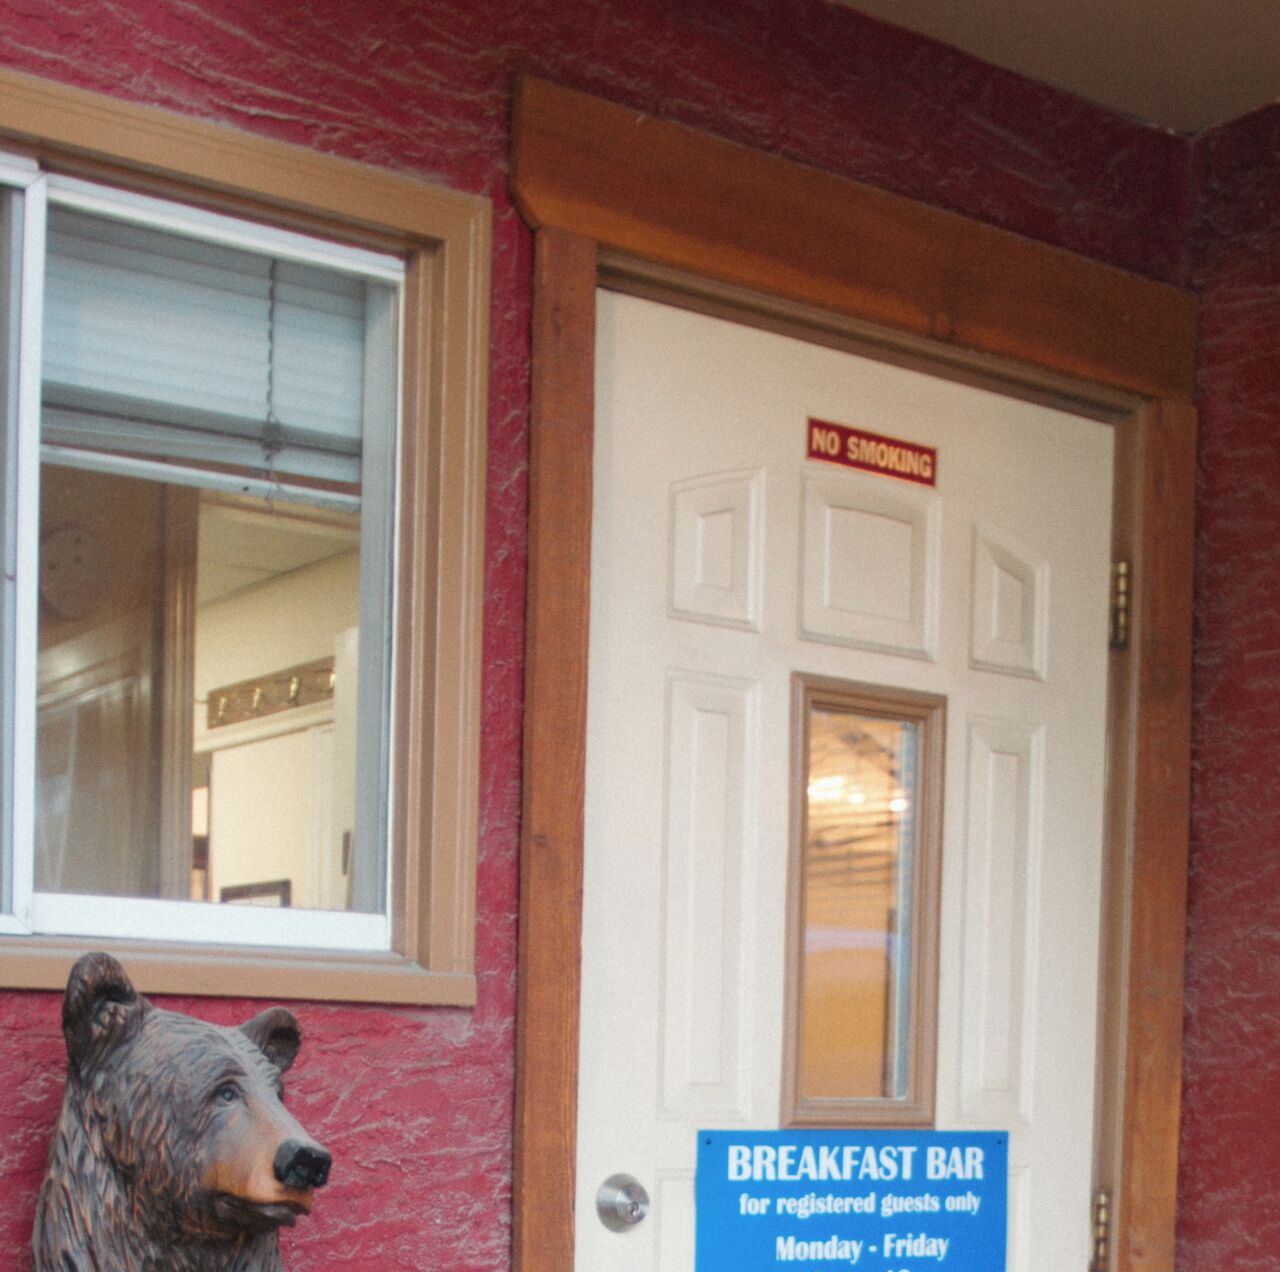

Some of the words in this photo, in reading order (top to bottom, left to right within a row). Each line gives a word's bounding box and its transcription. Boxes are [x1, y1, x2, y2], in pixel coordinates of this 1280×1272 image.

[811, 427, 841, 456] NO
[847, 435, 932, 479] SMOKING
[727, 1145, 917, 1181] BREAKFAST
[926, 1146, 984, 1180] BAR
[739, 1193, 771, 1215] for
[776, 1192, 876, 1219] registered
[880, 1193, 940, 1217] guests
[945, 1191, 981, 1214] only
[776, 1235, 863, 1264] Monday
[883, 1233, 949, 1261] Friday
